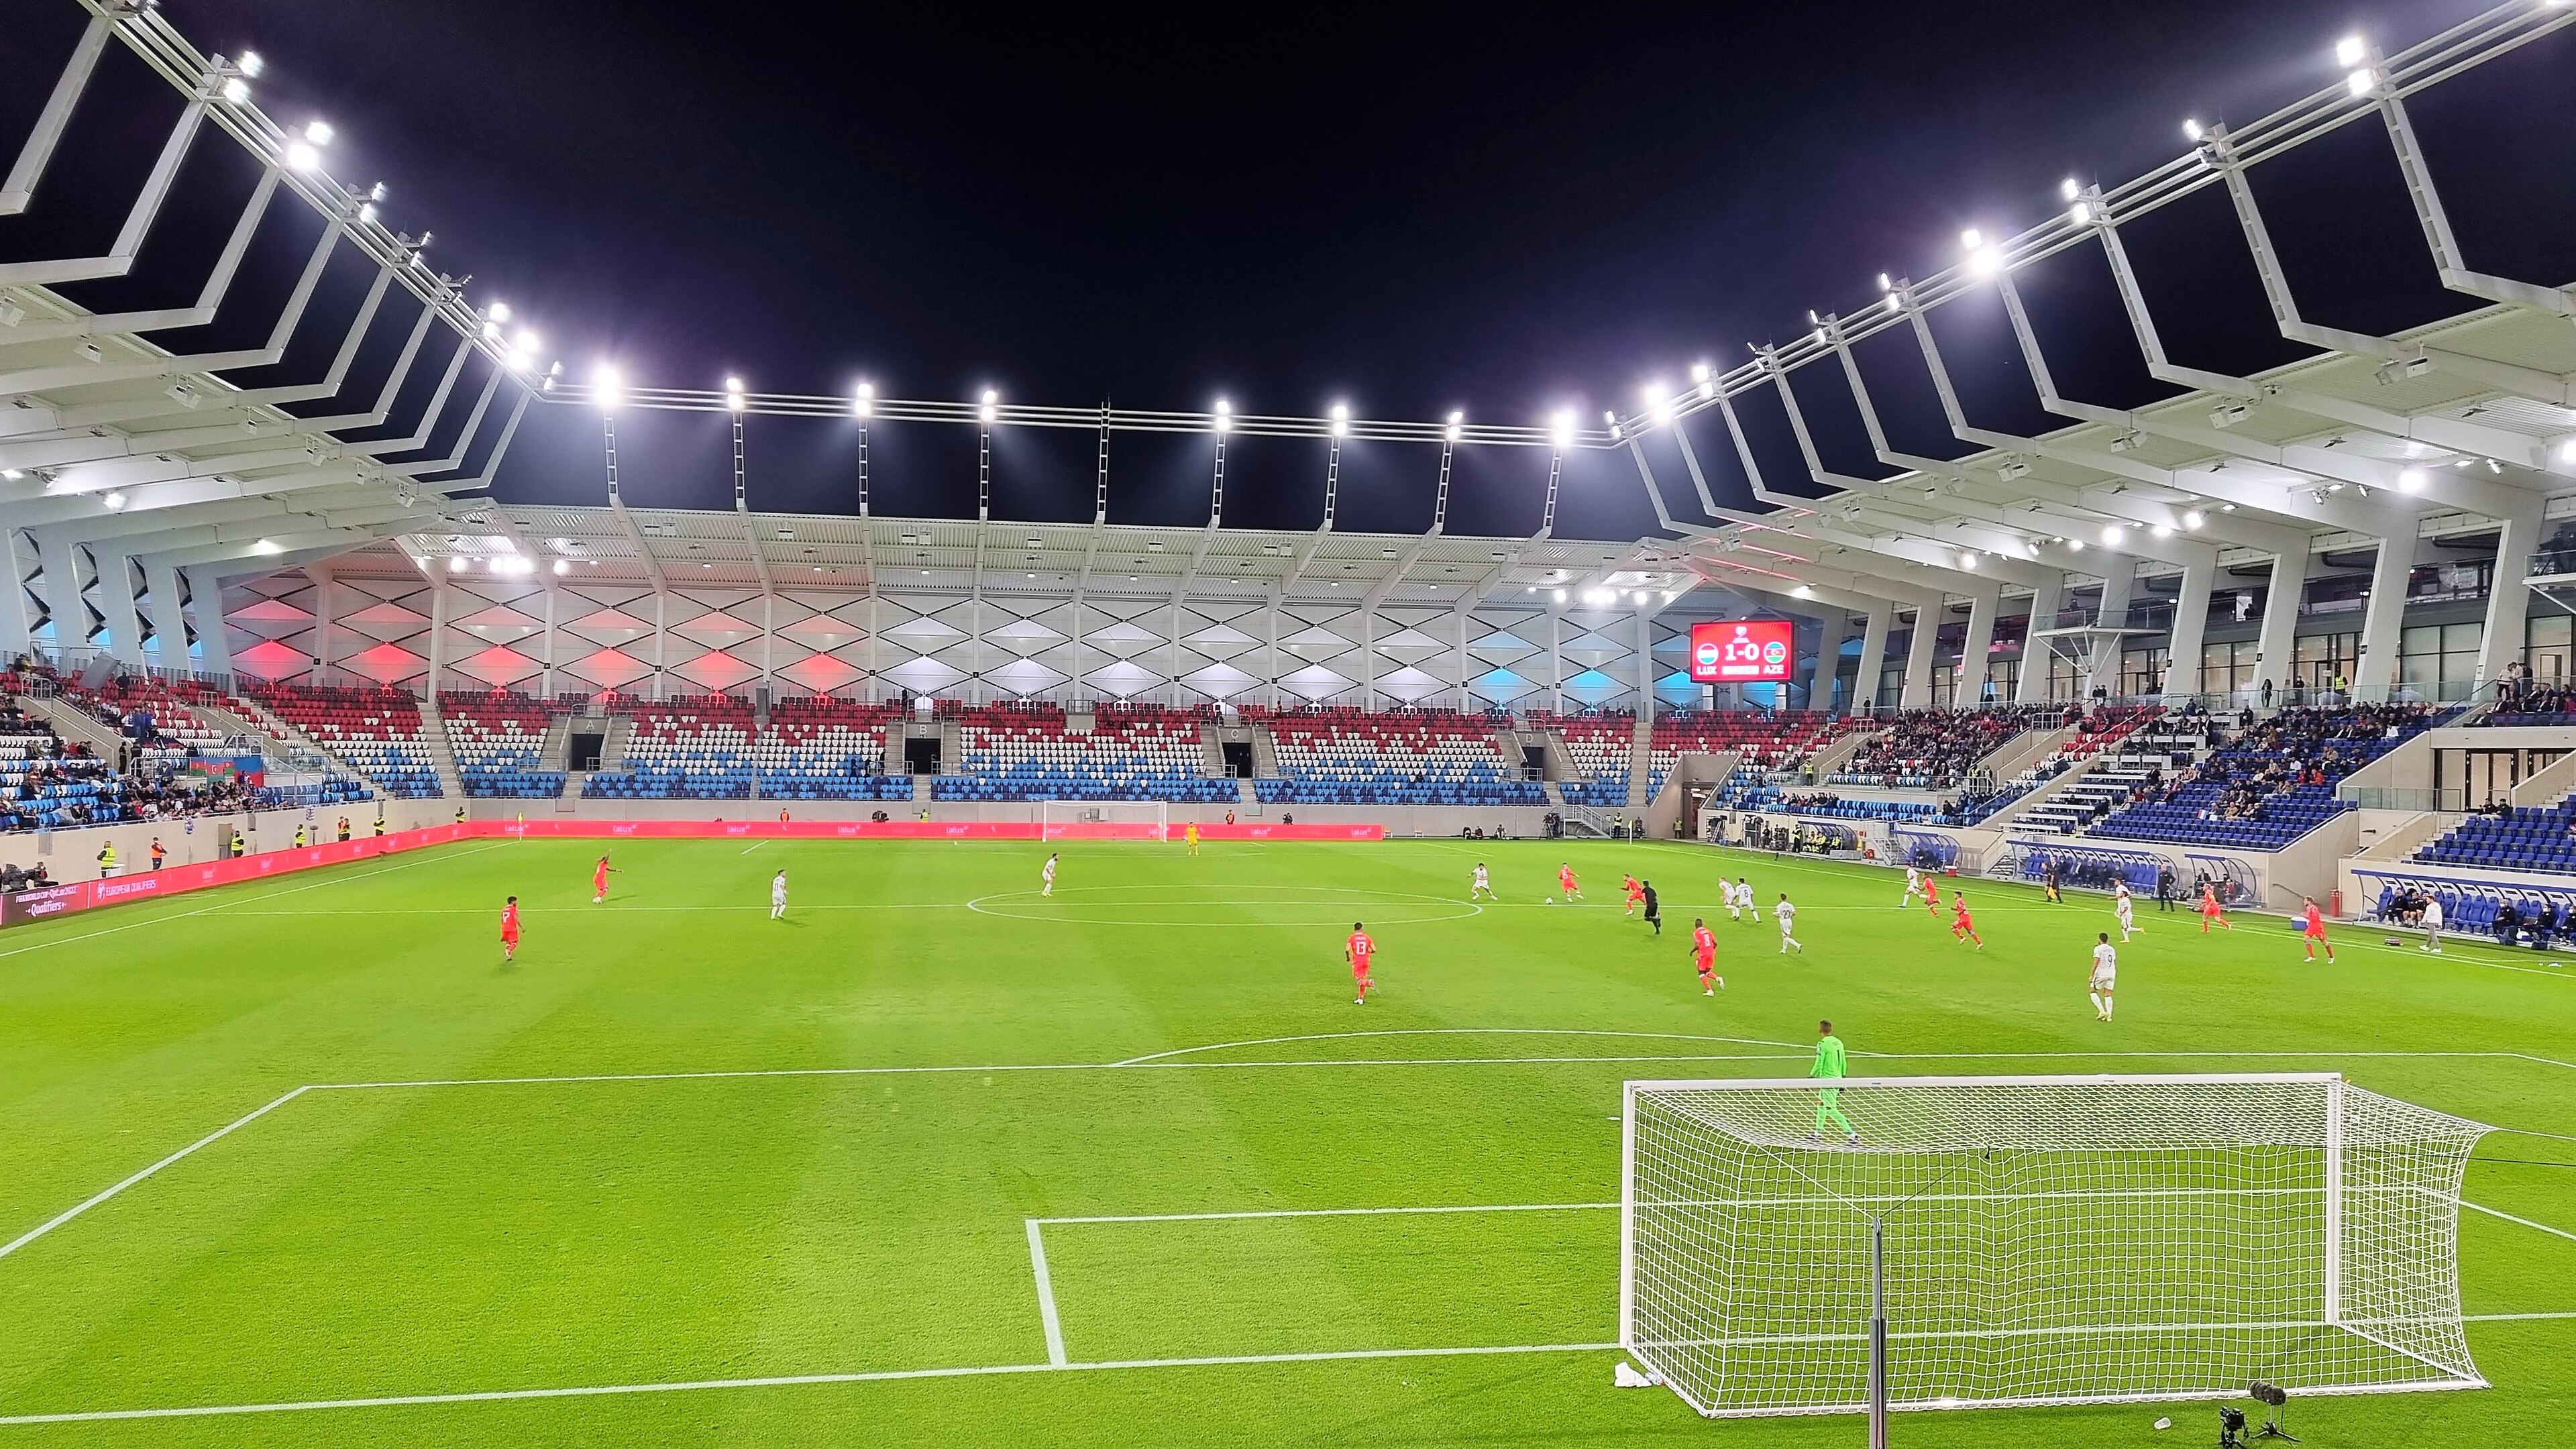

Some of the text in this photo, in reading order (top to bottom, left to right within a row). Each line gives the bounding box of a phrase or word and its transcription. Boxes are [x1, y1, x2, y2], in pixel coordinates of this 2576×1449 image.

[1725, 643, 1760, 661] 1-0
[1697, 665, 1717, 675] LUX
[1763, 665, 1784, 674] AZE
[586, 720, 594, 730] A
[920, 724, 927, 734] B
[1231, 729, 1239, 739] C
[1525, 733, 1534, 743] D
[31, 900, 62, 918] Qualifiers
[1782, 910, 1790, 919] 20
[2108, 954, 2112, 967] 9
